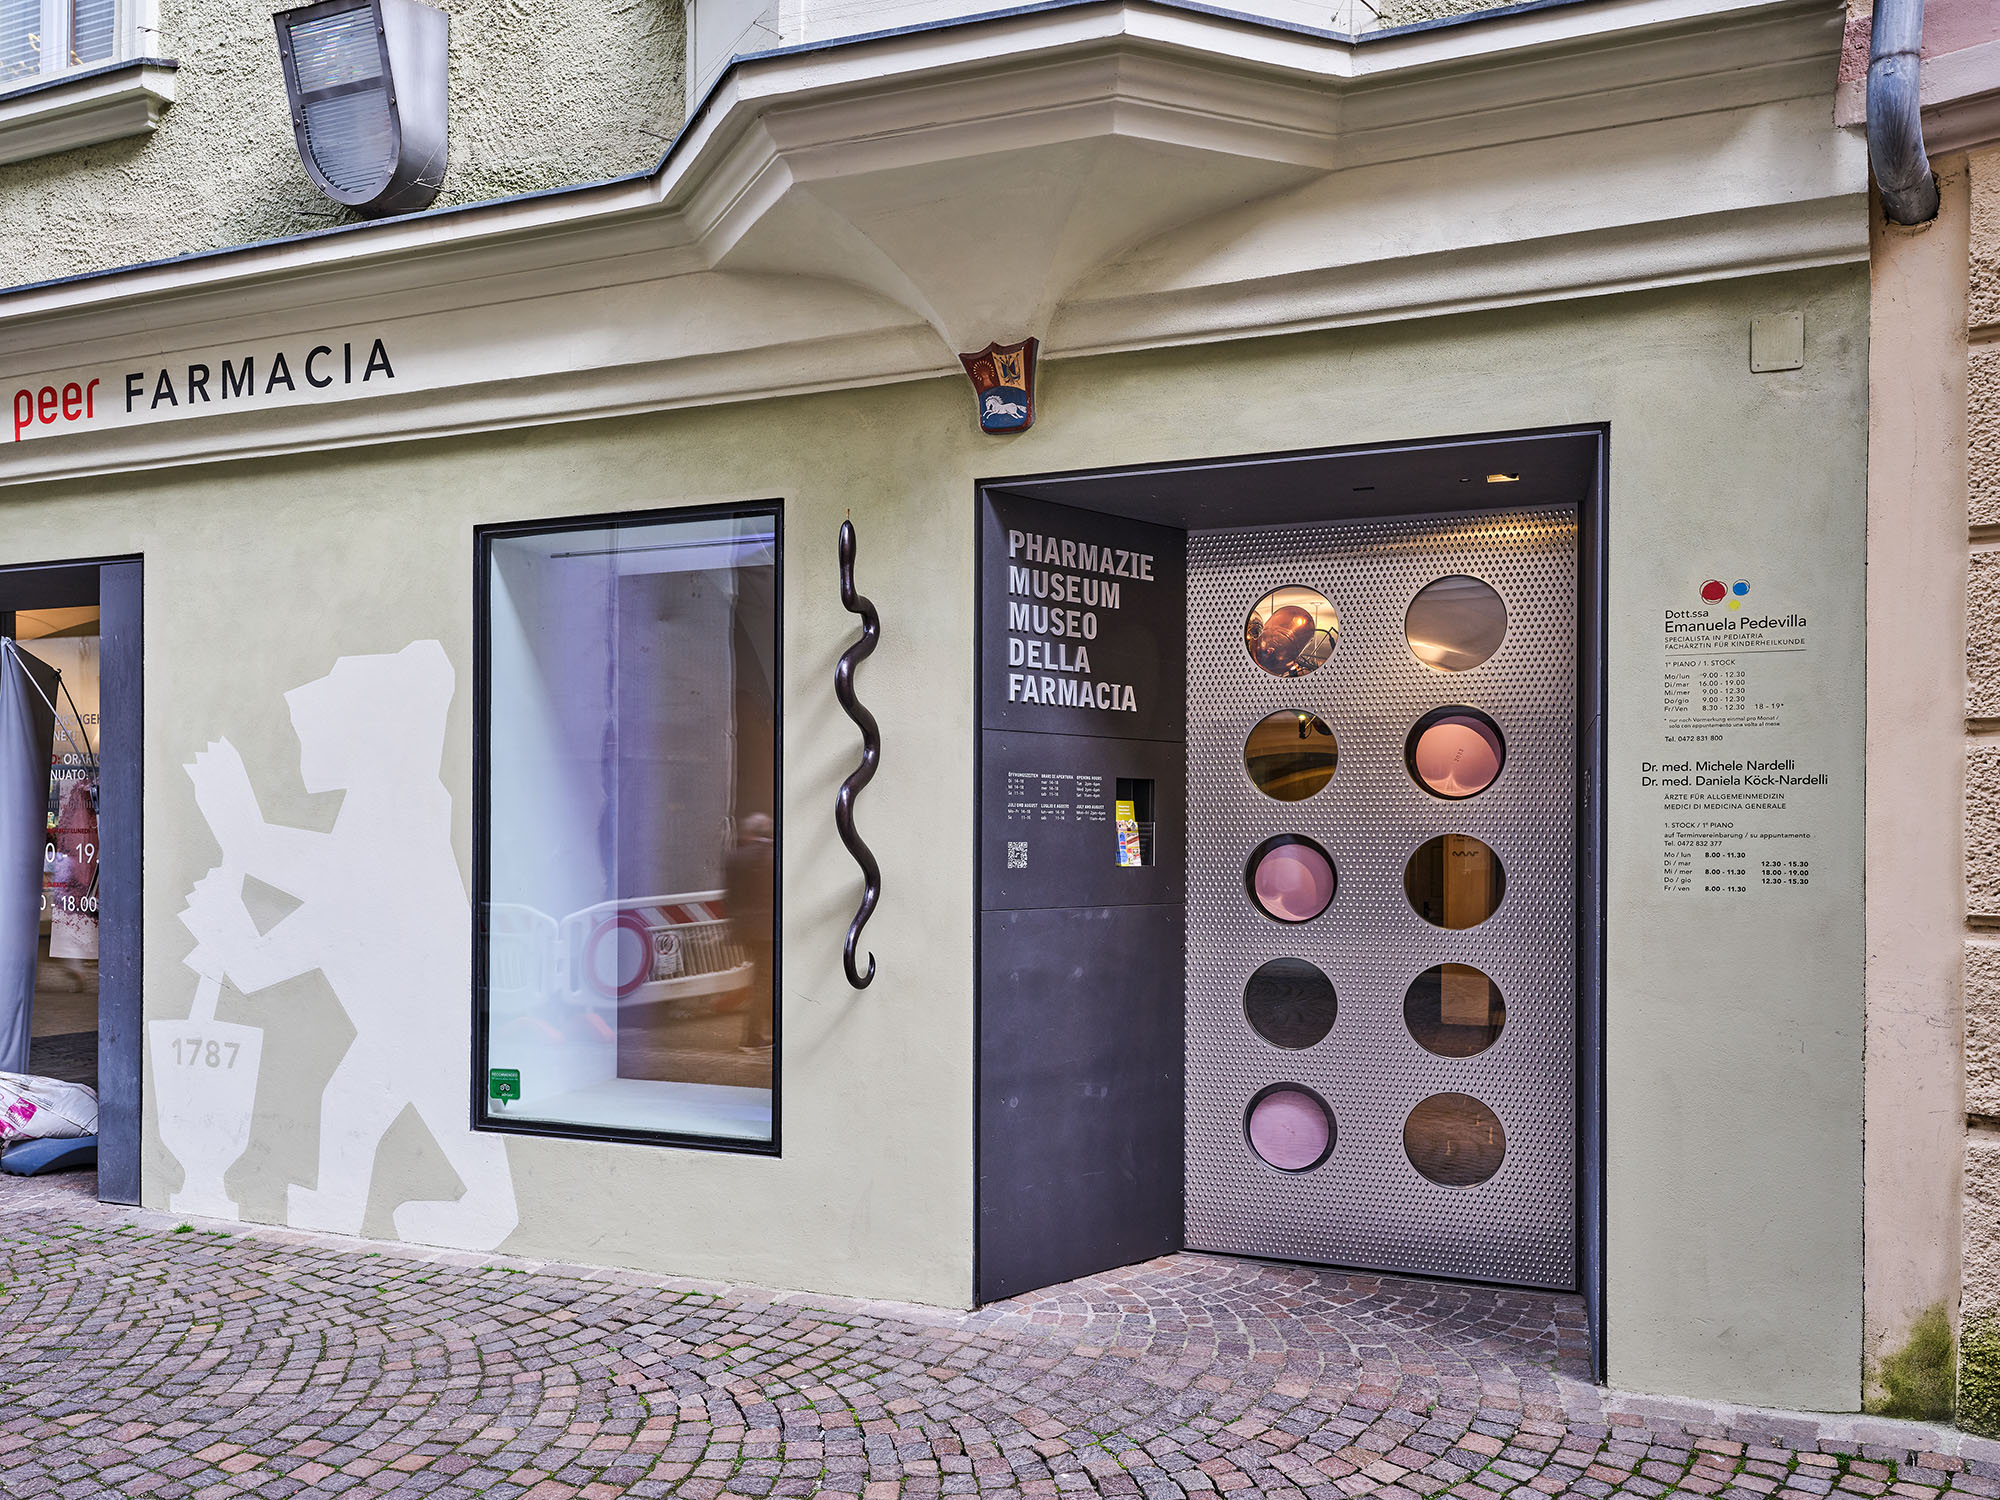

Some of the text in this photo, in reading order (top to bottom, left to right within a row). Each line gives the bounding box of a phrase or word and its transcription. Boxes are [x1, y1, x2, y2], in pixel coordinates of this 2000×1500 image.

[14, 338, 394, 442] peer FARMACIA
[1009, 529, 1154, 582] PHARMAZIE
[1009, 565, 1120, 610] MUSEUM
[1008, 602, 1098, 640] MUSEO
[1665, 614, 1806, 632] Emanuela Pedevilla
[1666, 610, 1708, 618] Dott.ssa
[1008, 638, 1091, 674] DELLA
[1732, 638, 1805, 647] KINDERHEILKUNDE
[1008, 673, 1137, 712] FARMACIA
[1642, 760, 1795, 772] Dr. med. Michele Nardelli
[1642, 774, 1828, 786] Dr. med. Daniela Köck-Nardelli
[62, 896, 97, 912] 18.00
[172, 1038, 240, 1069] 1787
